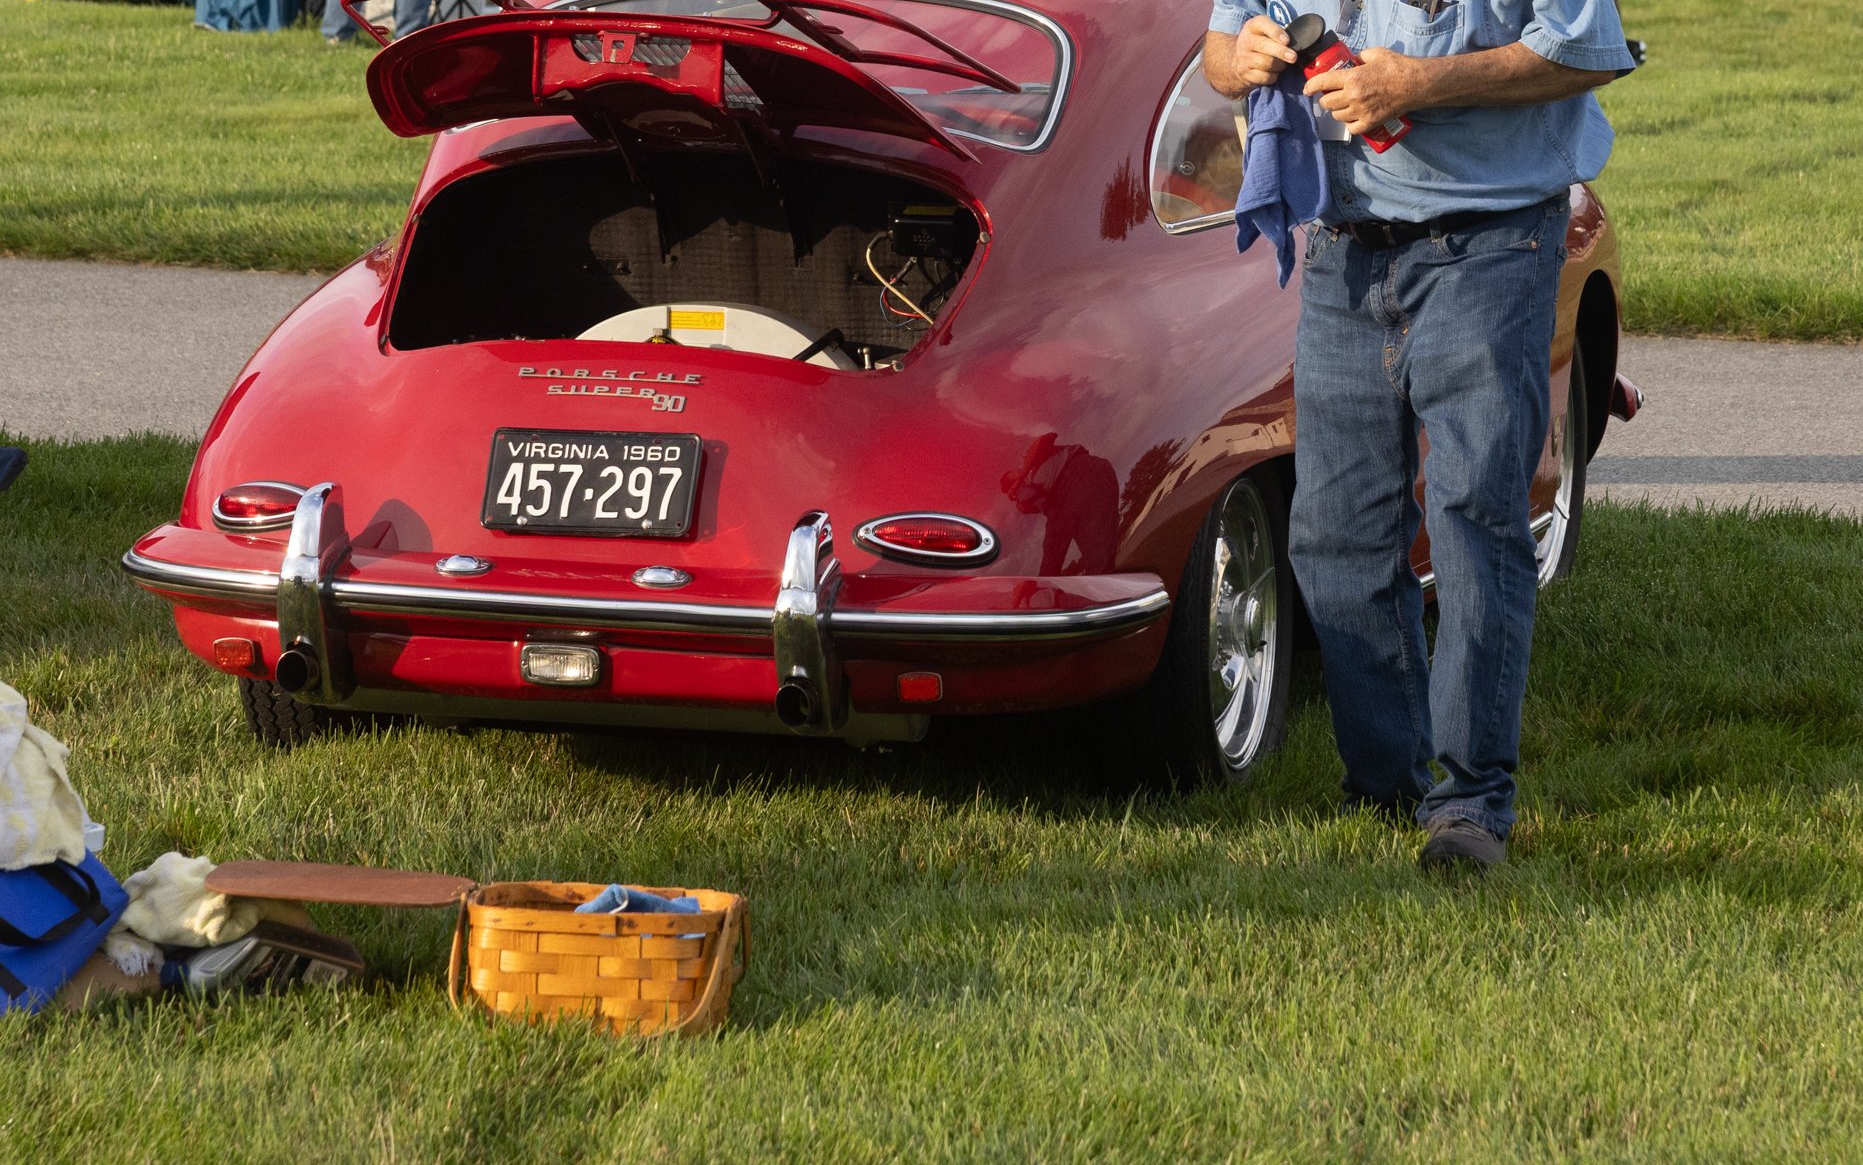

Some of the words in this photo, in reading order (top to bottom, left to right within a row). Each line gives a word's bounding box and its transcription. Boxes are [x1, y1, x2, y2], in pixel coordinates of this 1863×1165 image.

[518, 367, 702, 385] PORSCHE
[547, 385, 656, 399] SUPER
[652, 394, 686, 413] 90
[508, 442, 609, 460] VIRGINIA
[623, 445, 681, 462] 1960
